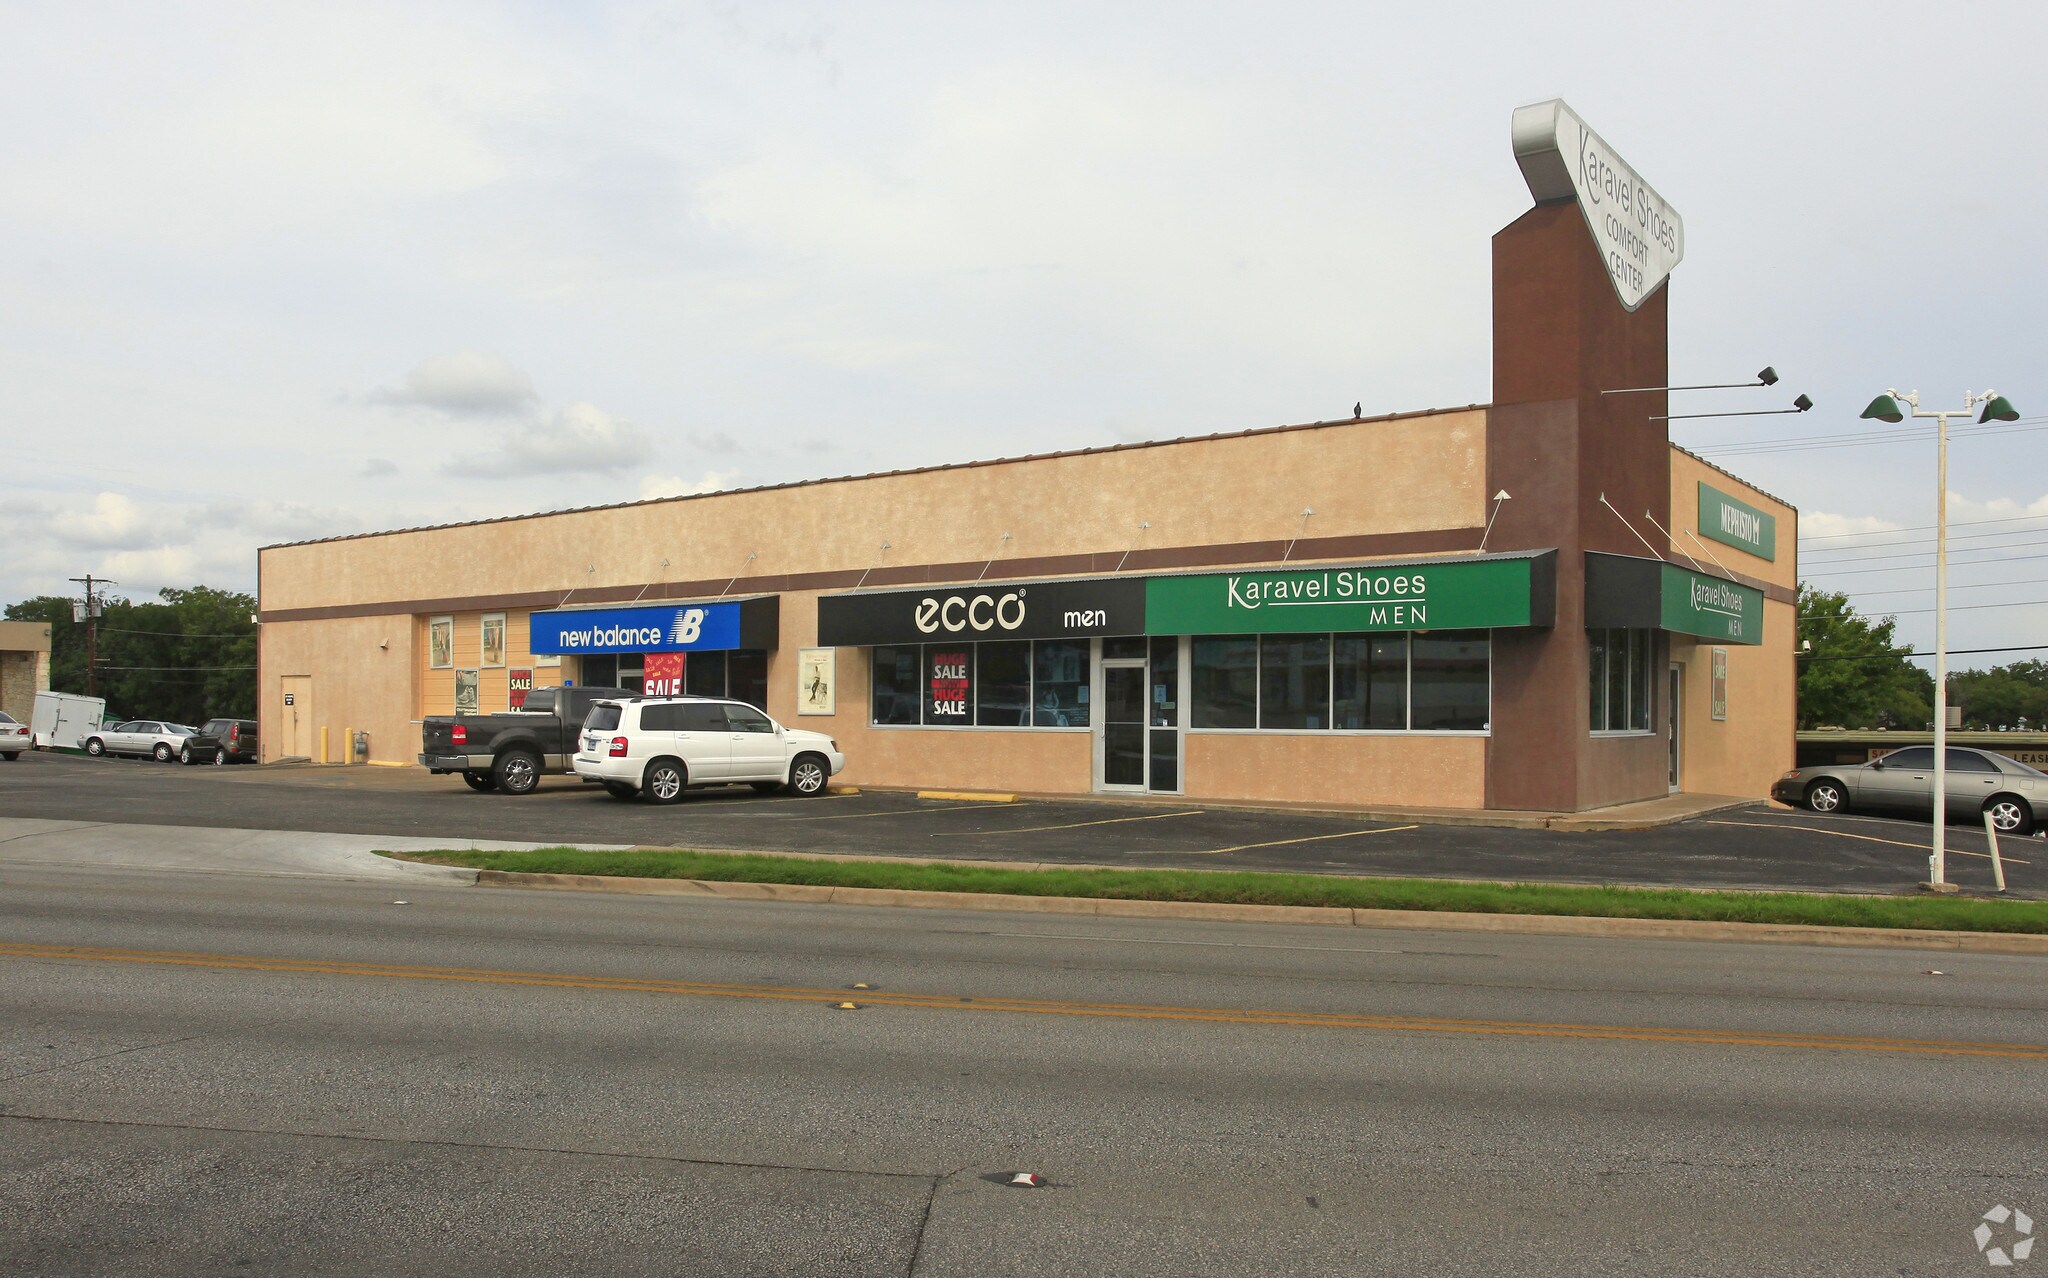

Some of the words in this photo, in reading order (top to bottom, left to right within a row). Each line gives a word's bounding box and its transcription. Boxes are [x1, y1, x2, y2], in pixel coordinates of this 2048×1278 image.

[1578, 124, 1633, 216] Karavel
[1637, 186, 1675, 254] Shoes
[1605, 212, 1649, 268] COMFORT
[1609, 250, 1643, 296] CENTER
[1720, 502, 1752, 543] MEPHISTO
[1227, 573, 1329, 609] Karavel
[1336, 571, 1426, 597] Shoes
[1690, 577, 1720, 611] Karavel
[1721, 584, 1742, 611] Shoes
[914, 593, 1026, 634] ecco
[1064, 609, 1106, 628] men
[1369, 605, 1426, 625] MEN
[559, 630, 592, 647] new
[593, 624, 662, 647] balance
[1728, 619, 1742, 636] MEN
[933, 653, 966, 665] HUGE
[934, 664, 966, 679] SALE
[511, 679, 531, 690] SALE
[933, 689, 966, 701] HUGE
[934, 700, 966, 715] SALE
